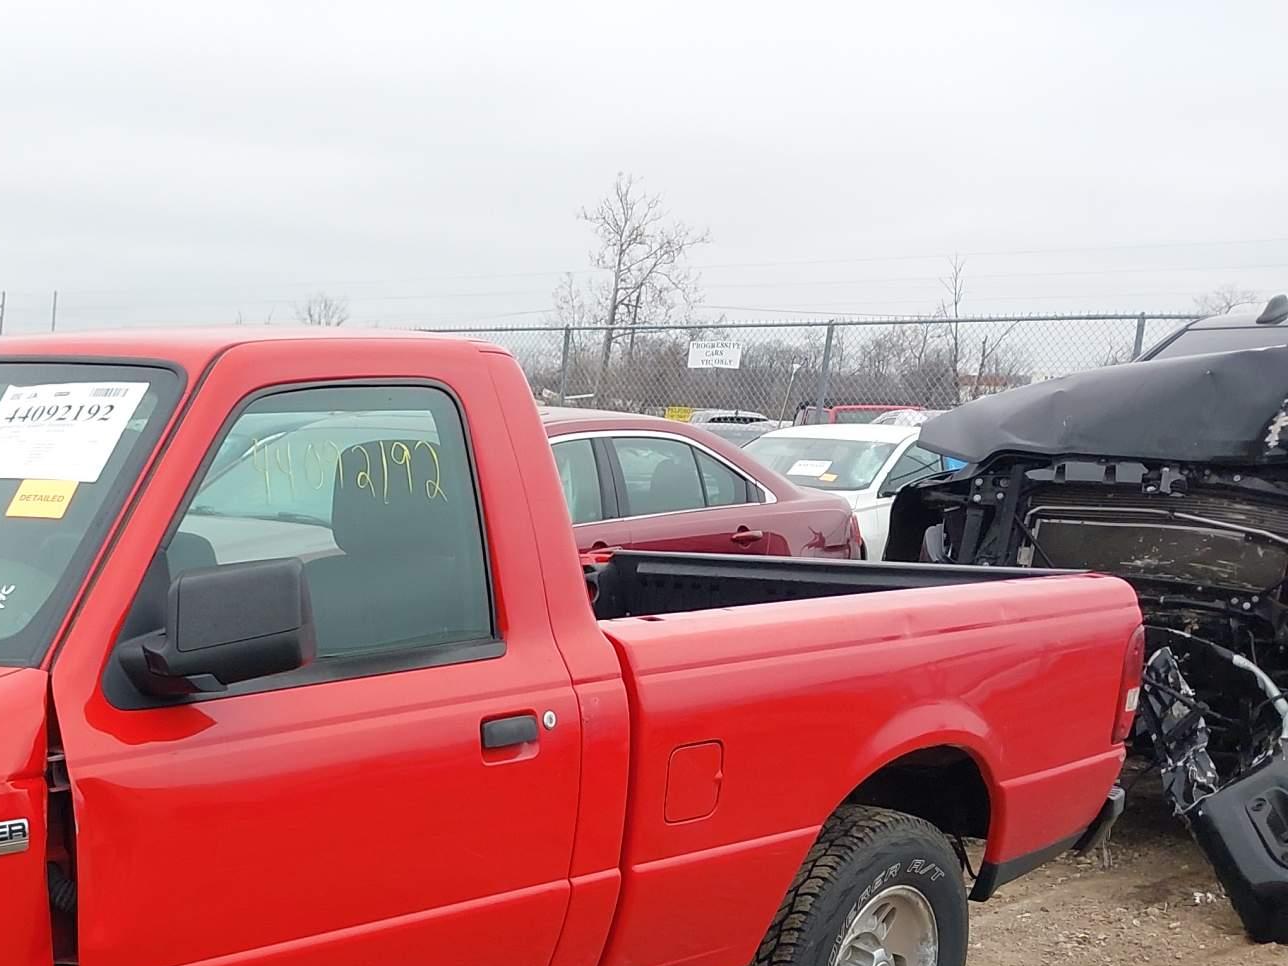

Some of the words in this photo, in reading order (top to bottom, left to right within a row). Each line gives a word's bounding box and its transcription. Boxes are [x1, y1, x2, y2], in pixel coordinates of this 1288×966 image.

[4, 403, 116, 423] 44092192
[252, 437, 449, 504] 44092192
[18, 494, 65, 503] DETAILED
[907, 859, 945, 882] A/T
